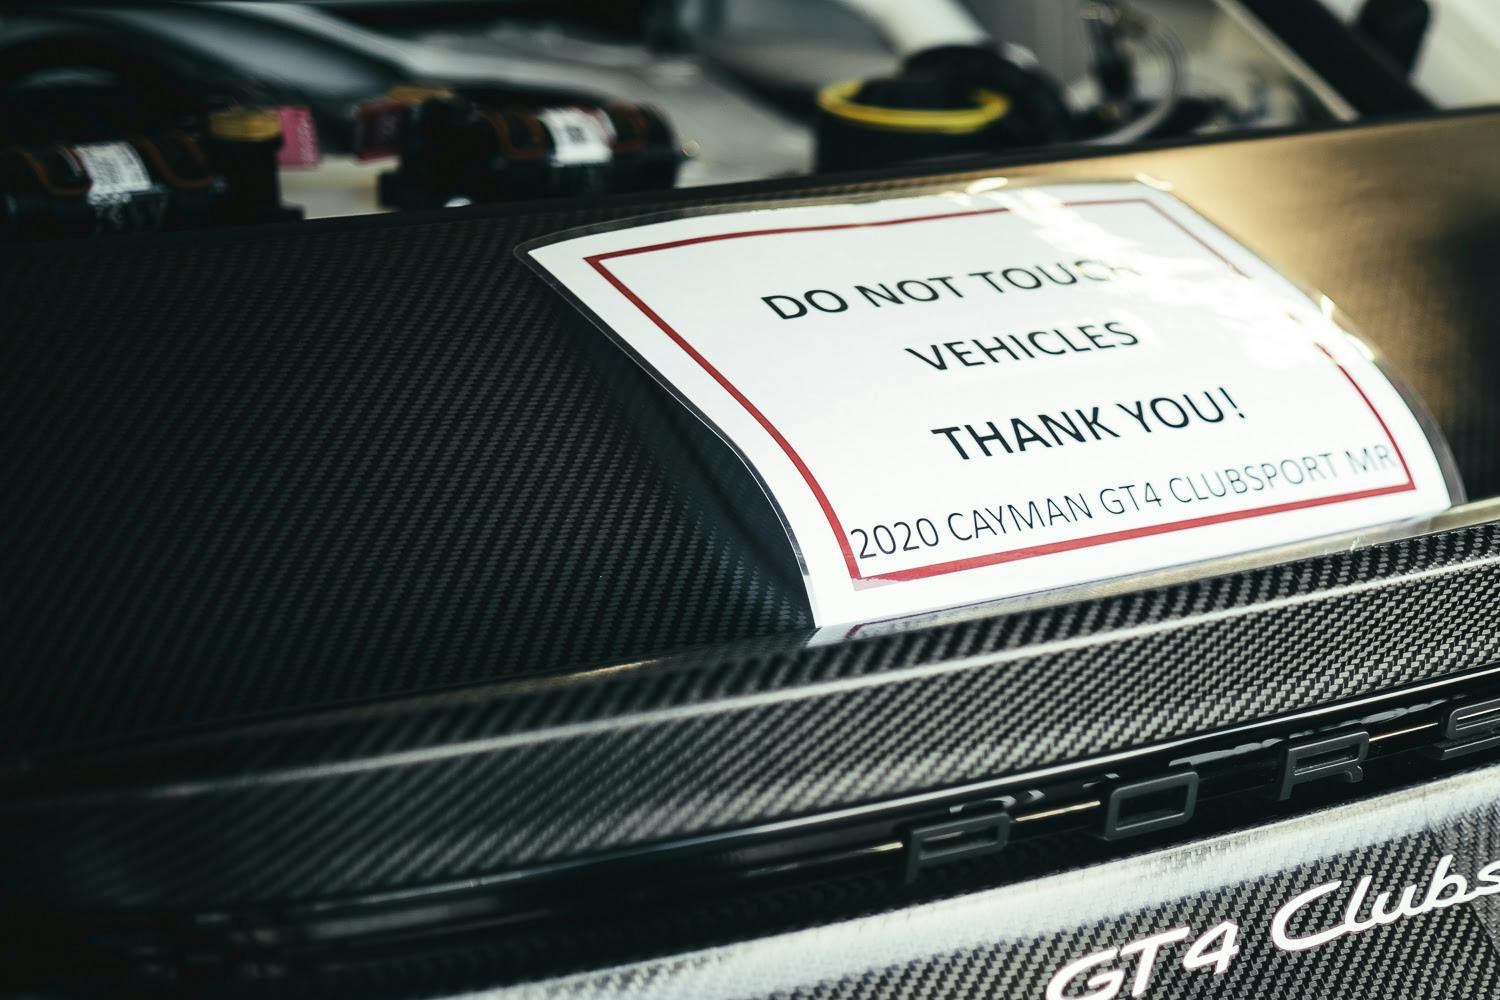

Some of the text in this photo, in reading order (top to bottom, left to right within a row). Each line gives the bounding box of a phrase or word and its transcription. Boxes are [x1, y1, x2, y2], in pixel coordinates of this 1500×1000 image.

[761, 289, 849, 320] DO
[854, 275, 964, 308] NOT
[904, 321, 1139, 371] VEHICLES
[931, 386, 1246, 460] THANK YOU!
[850, 444, 1398, 560] 2020 CAYMAN GT4 CLUBSPORT MR
